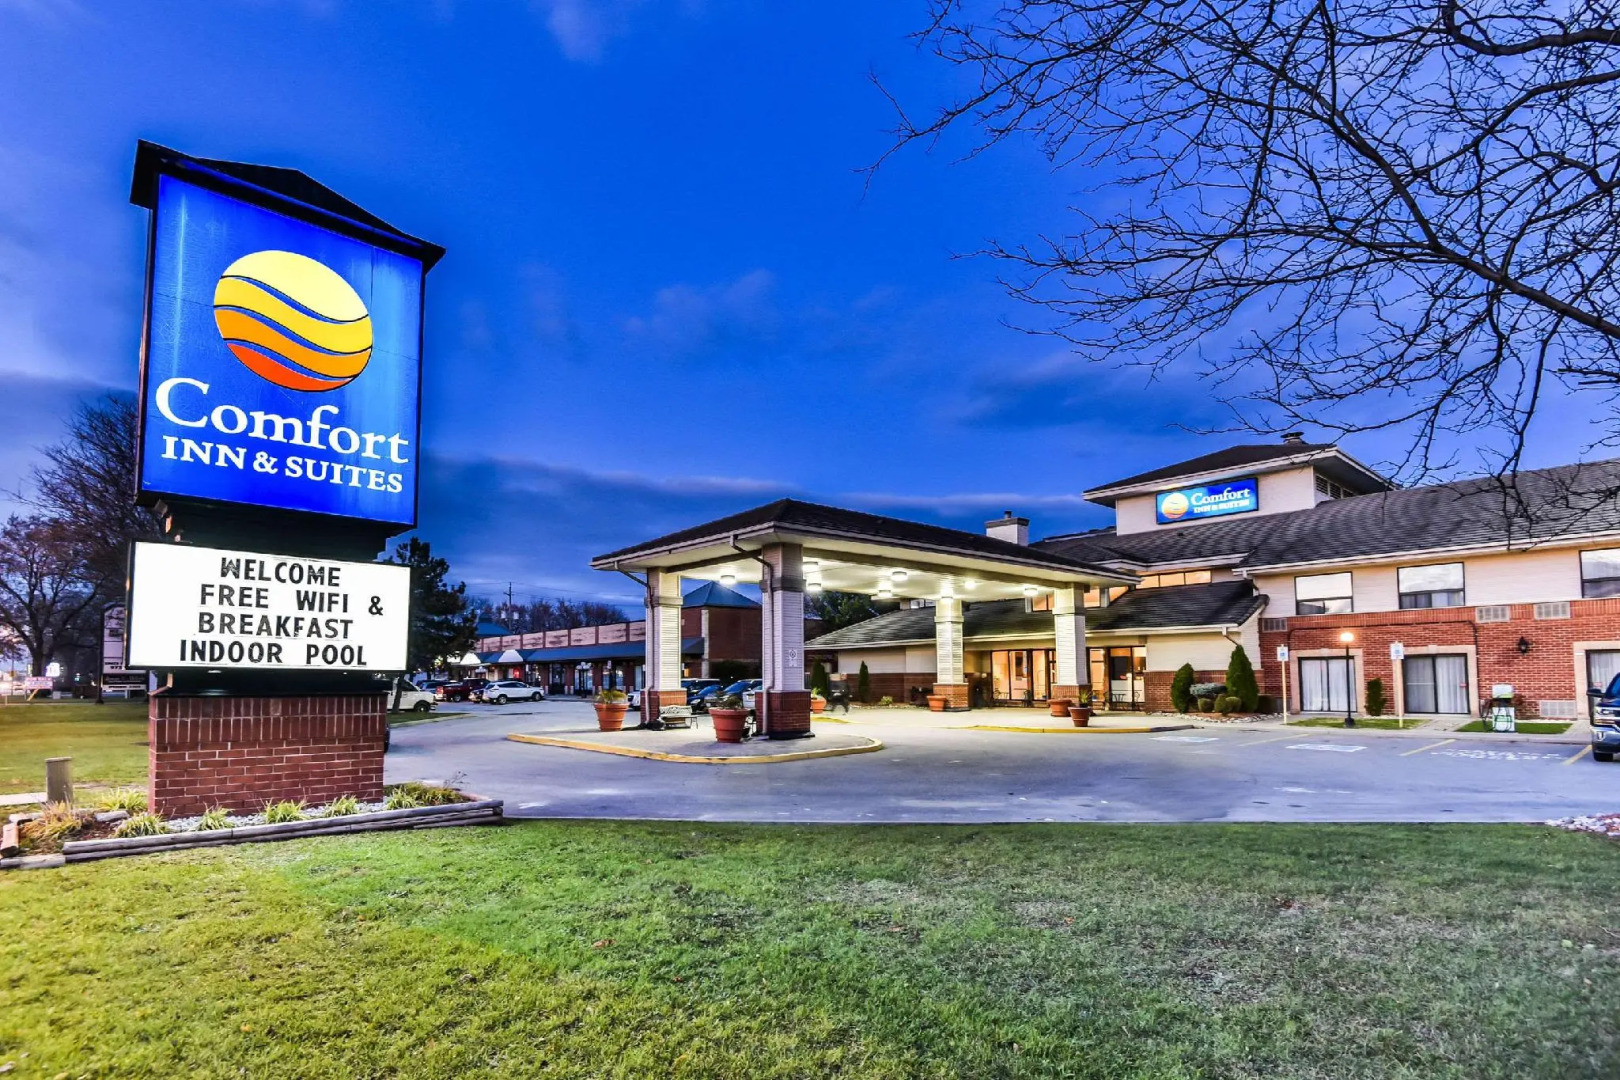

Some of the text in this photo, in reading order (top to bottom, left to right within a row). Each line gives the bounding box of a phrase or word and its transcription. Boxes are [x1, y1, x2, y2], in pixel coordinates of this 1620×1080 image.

[156, 378, 409, 464] Comfort
[162, 436, 402, 493] INN & SUITES
[1191, 487, 1250, 506] Comfort
[220, 558, 341, 587] WELCOME
[200, 584, 384, 616] FREE WIFI &
[199, 612, 354, 639] BREAKFAST
[180, 640, 367, 666] INDOOR POOL
